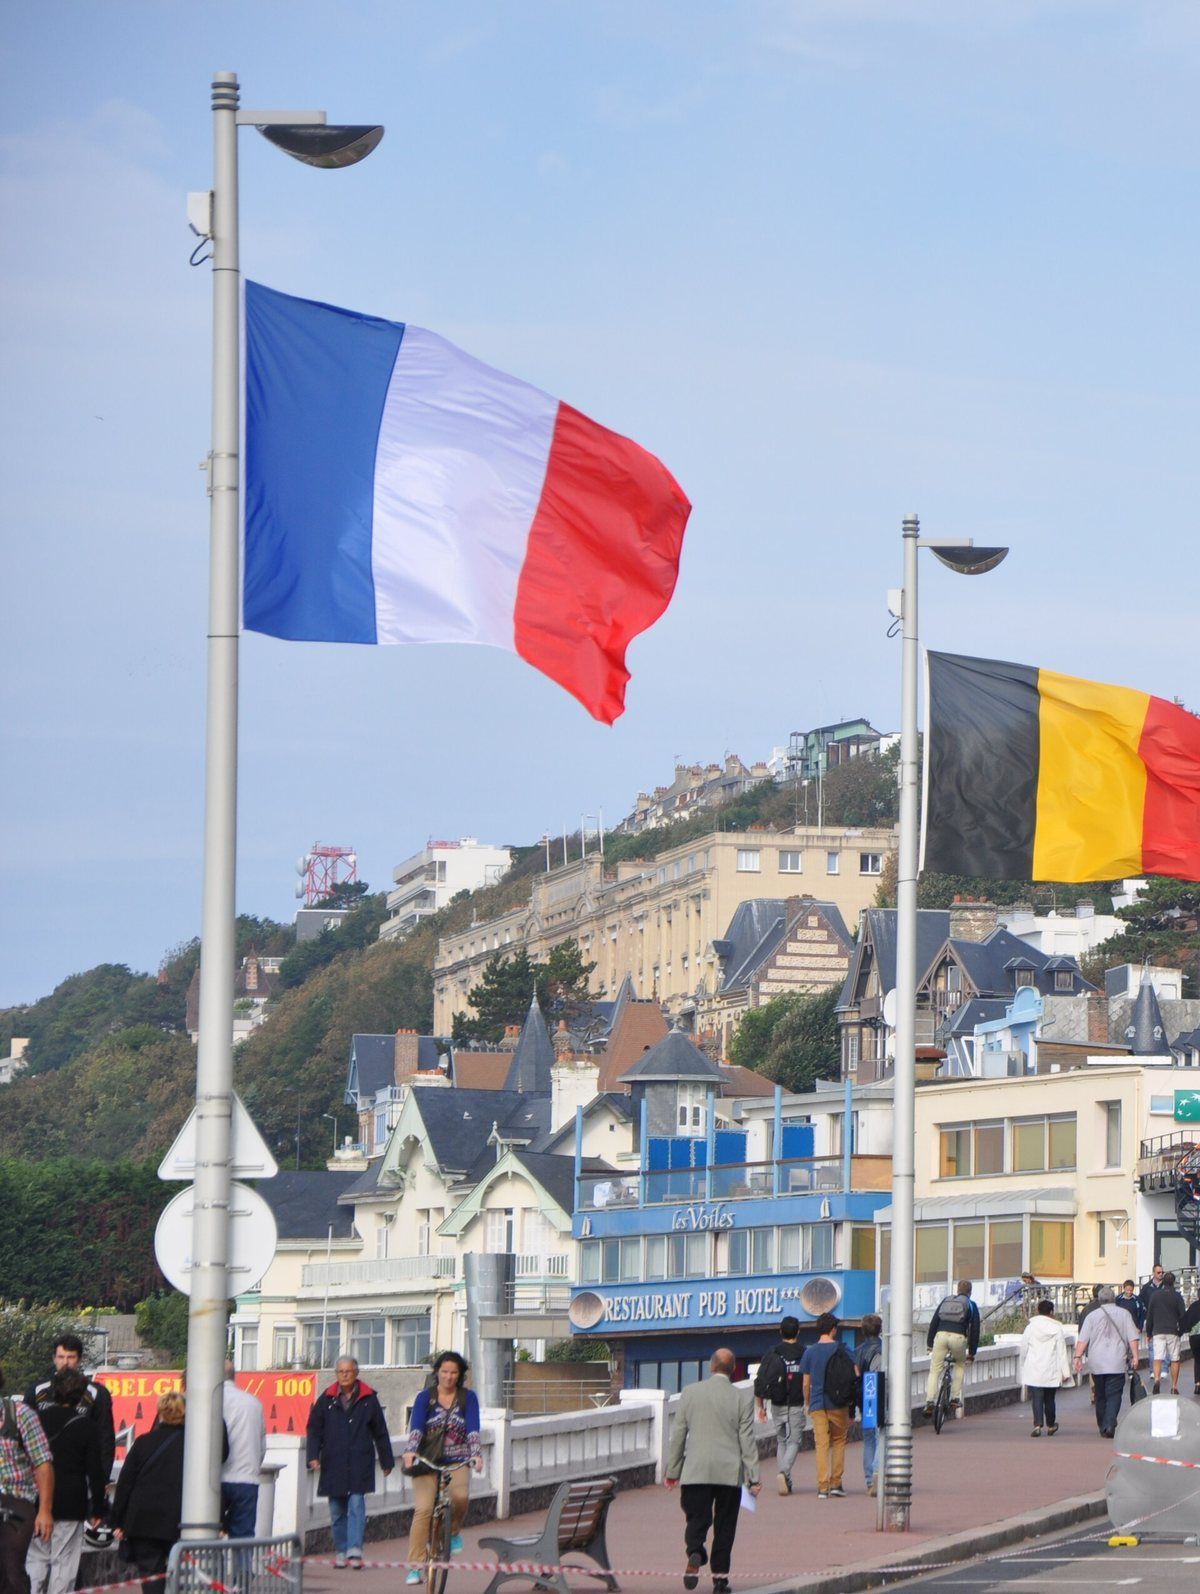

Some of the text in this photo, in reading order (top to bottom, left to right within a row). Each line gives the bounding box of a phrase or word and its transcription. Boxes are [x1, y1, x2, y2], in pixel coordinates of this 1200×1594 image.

[672, 1204, 737, 1231] les Voiles
[604, 1292, 691, 1321] RESTAURANT
[698, 1291, 727, 1317] PUB
[104, 1378, 186, 1397] BELGI
[274, 1378, 312, 1396] 100
